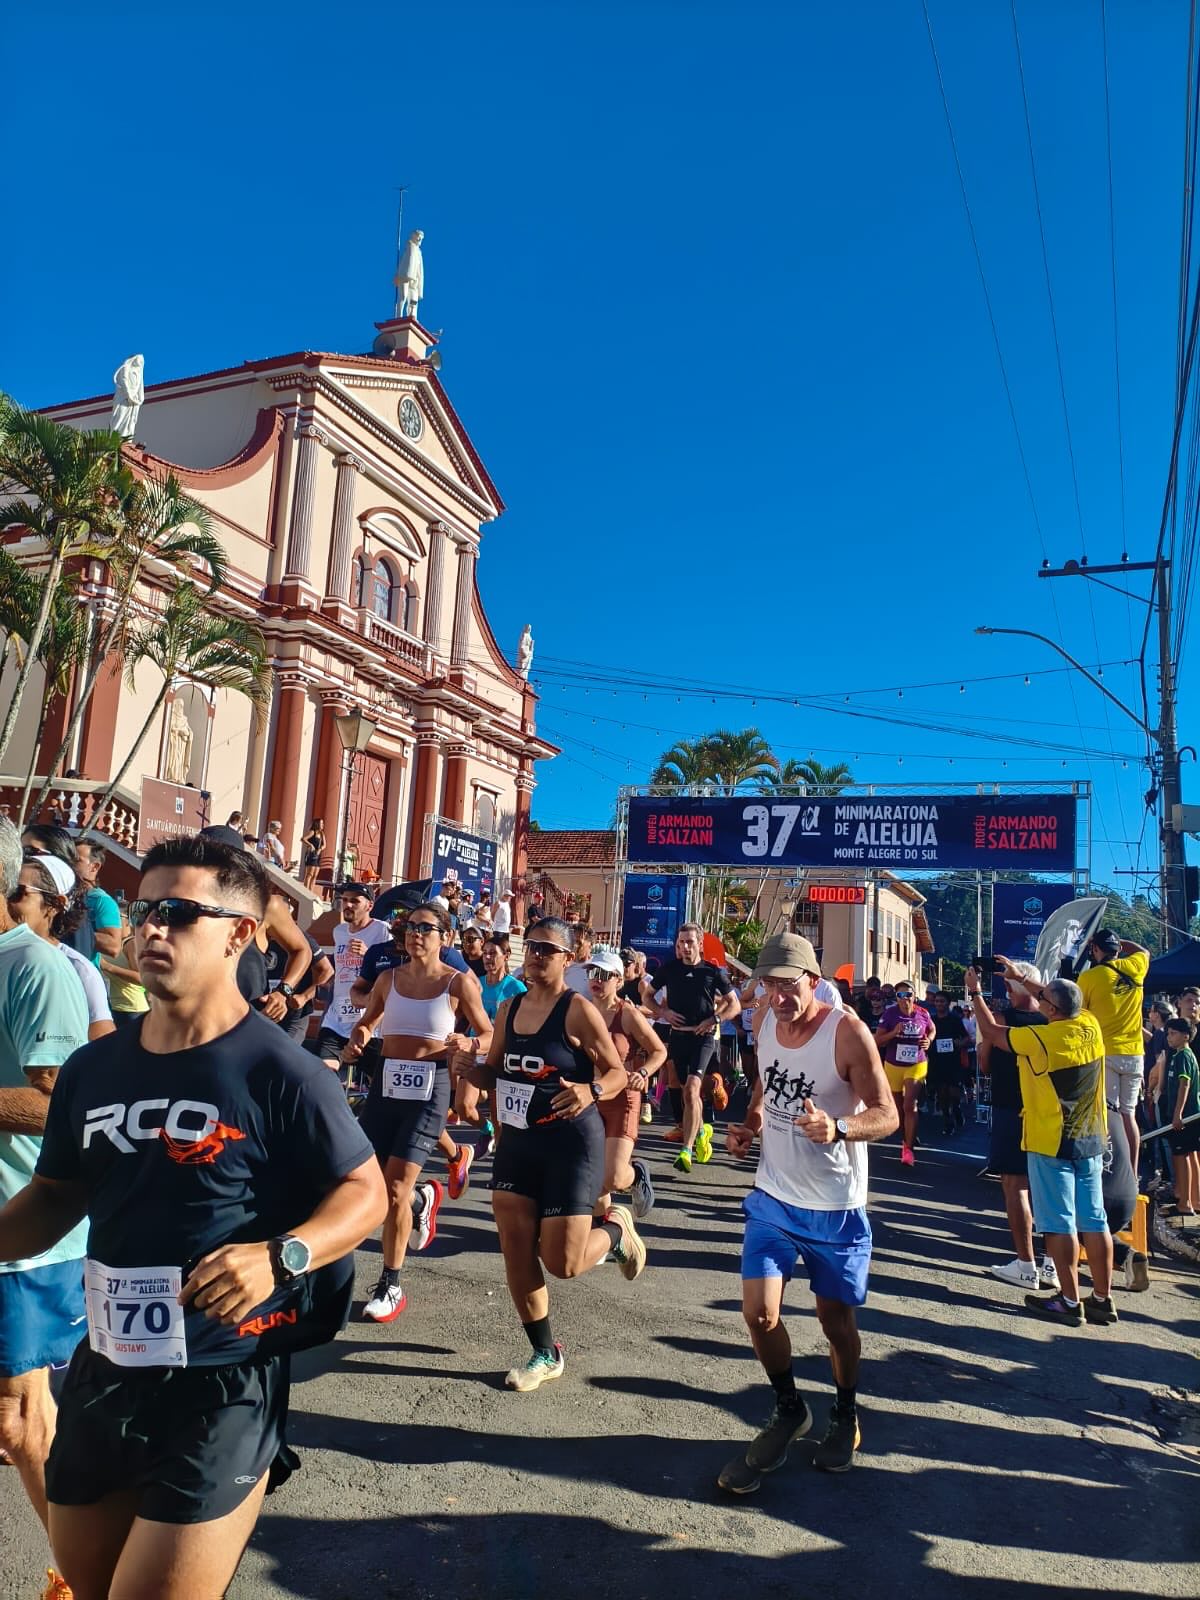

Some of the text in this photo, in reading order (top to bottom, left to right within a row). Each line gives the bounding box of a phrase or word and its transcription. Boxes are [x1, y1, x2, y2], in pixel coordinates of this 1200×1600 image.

[835, 805, 939, 820] MINIMARATONA
[146, 818, 177, 834] SANTUÁRIO
[647, 814, 658, 844] TROFÉU
[658, 815, 713, 828] ARMANDO
[988, 815, 1058, 830] ARMANDO
[658, 829, 713, 846] SALZANI
[834, 822, 939, 846] DE ALELUIA
[973, 815, 986, 849] TROFÉU
[988, 832, 1058, 849] SALZANI
[834, 848, 938, 860] MONTE ALEGRE DO SUL
[392, 1073, 424, 1088] 350
[83, 1098, 220, 1154] RCO
[139, 1284, 170, 1294] ALELUIA
[103, 1299, 171, 1335] 170
[238, 1308, 297, 1337] RUN
[114, 1343, 147, 1353] GUSTAVO
